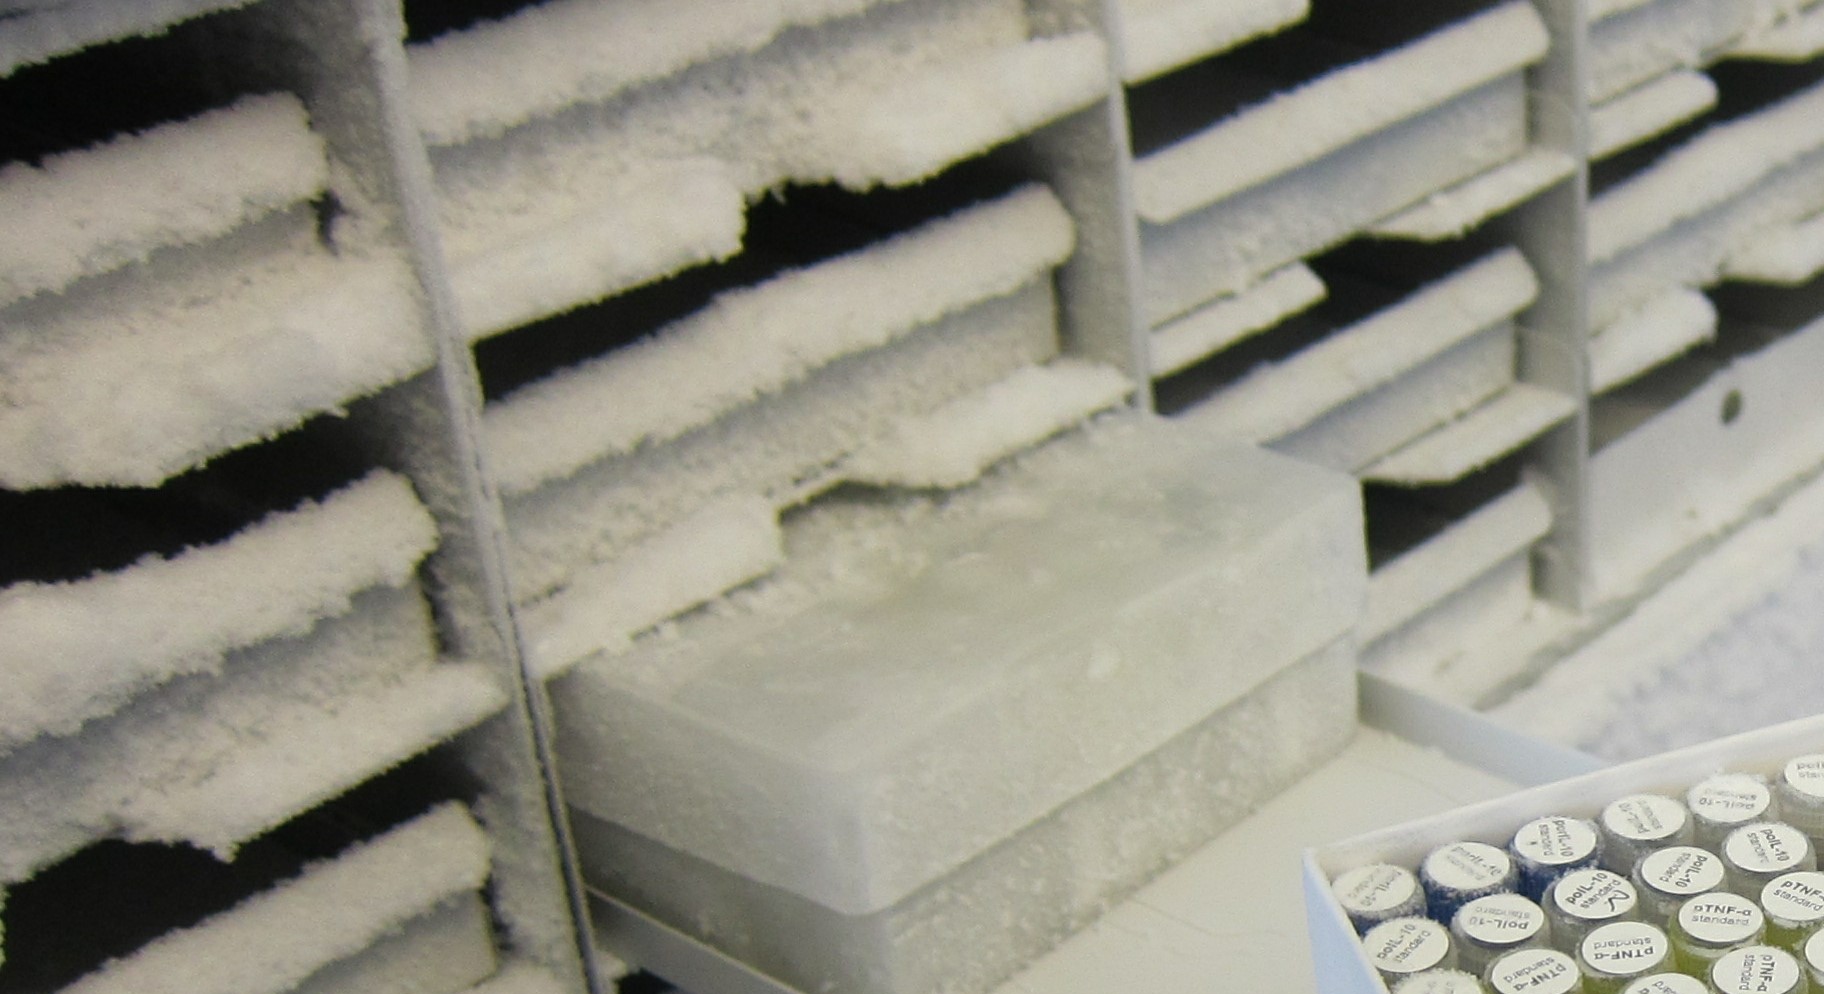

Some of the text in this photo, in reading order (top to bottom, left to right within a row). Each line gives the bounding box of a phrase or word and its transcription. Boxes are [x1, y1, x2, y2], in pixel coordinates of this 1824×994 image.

[1660, 852, 1691, 882] standard
[1580, 880, 1621, 909] standard
[1774, 889, 1824, 912] standard
[1475, 906, 1531, 920] standard
[1691, 915, 1749, 926] standard
[1594, 937, 1652, 950] standard
[1503, 956, 1555, 983] standard
[1739, 953, 1756, 991] standard
